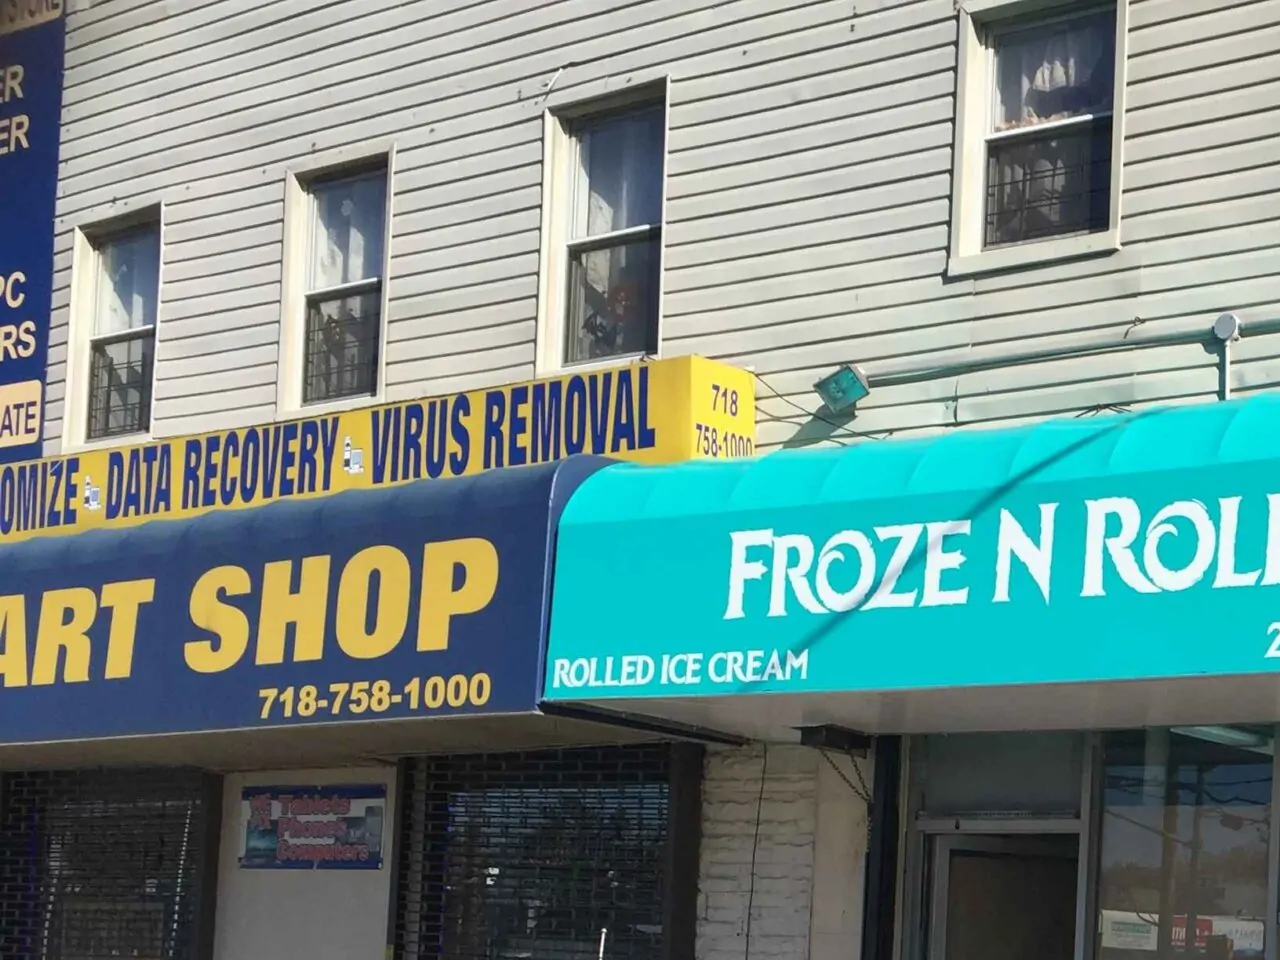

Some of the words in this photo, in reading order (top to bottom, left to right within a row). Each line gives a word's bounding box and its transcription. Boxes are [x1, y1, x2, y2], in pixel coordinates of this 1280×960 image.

[712, 384, 738, 416] 718
[0, 457, 80, 535] OMIZE
[105, 443, 171, 520] DATA
[181, 417, 340, 510] RECOVERY
[371, 393, 471, 485] VIRUS
[483, 366, 656, 470] REMOVAL
[696, 423, 752, 458] 758-1000
[723, 520, 971, 620] FROZE
[991, 502, 1060, 606] N
[0, 578, 155, 688] ART
[184, 537, 499, 674] SHOP
[553, 655, 655, 688] ROLLED
[660, 653, 703, 685] ICE
[708, 648, 809, 683] CREAM
[258, 672, 492, 719] 718-758-1000
[278, 794, 350, 815] Tablets
[276, 839, 369, 861] Computers
